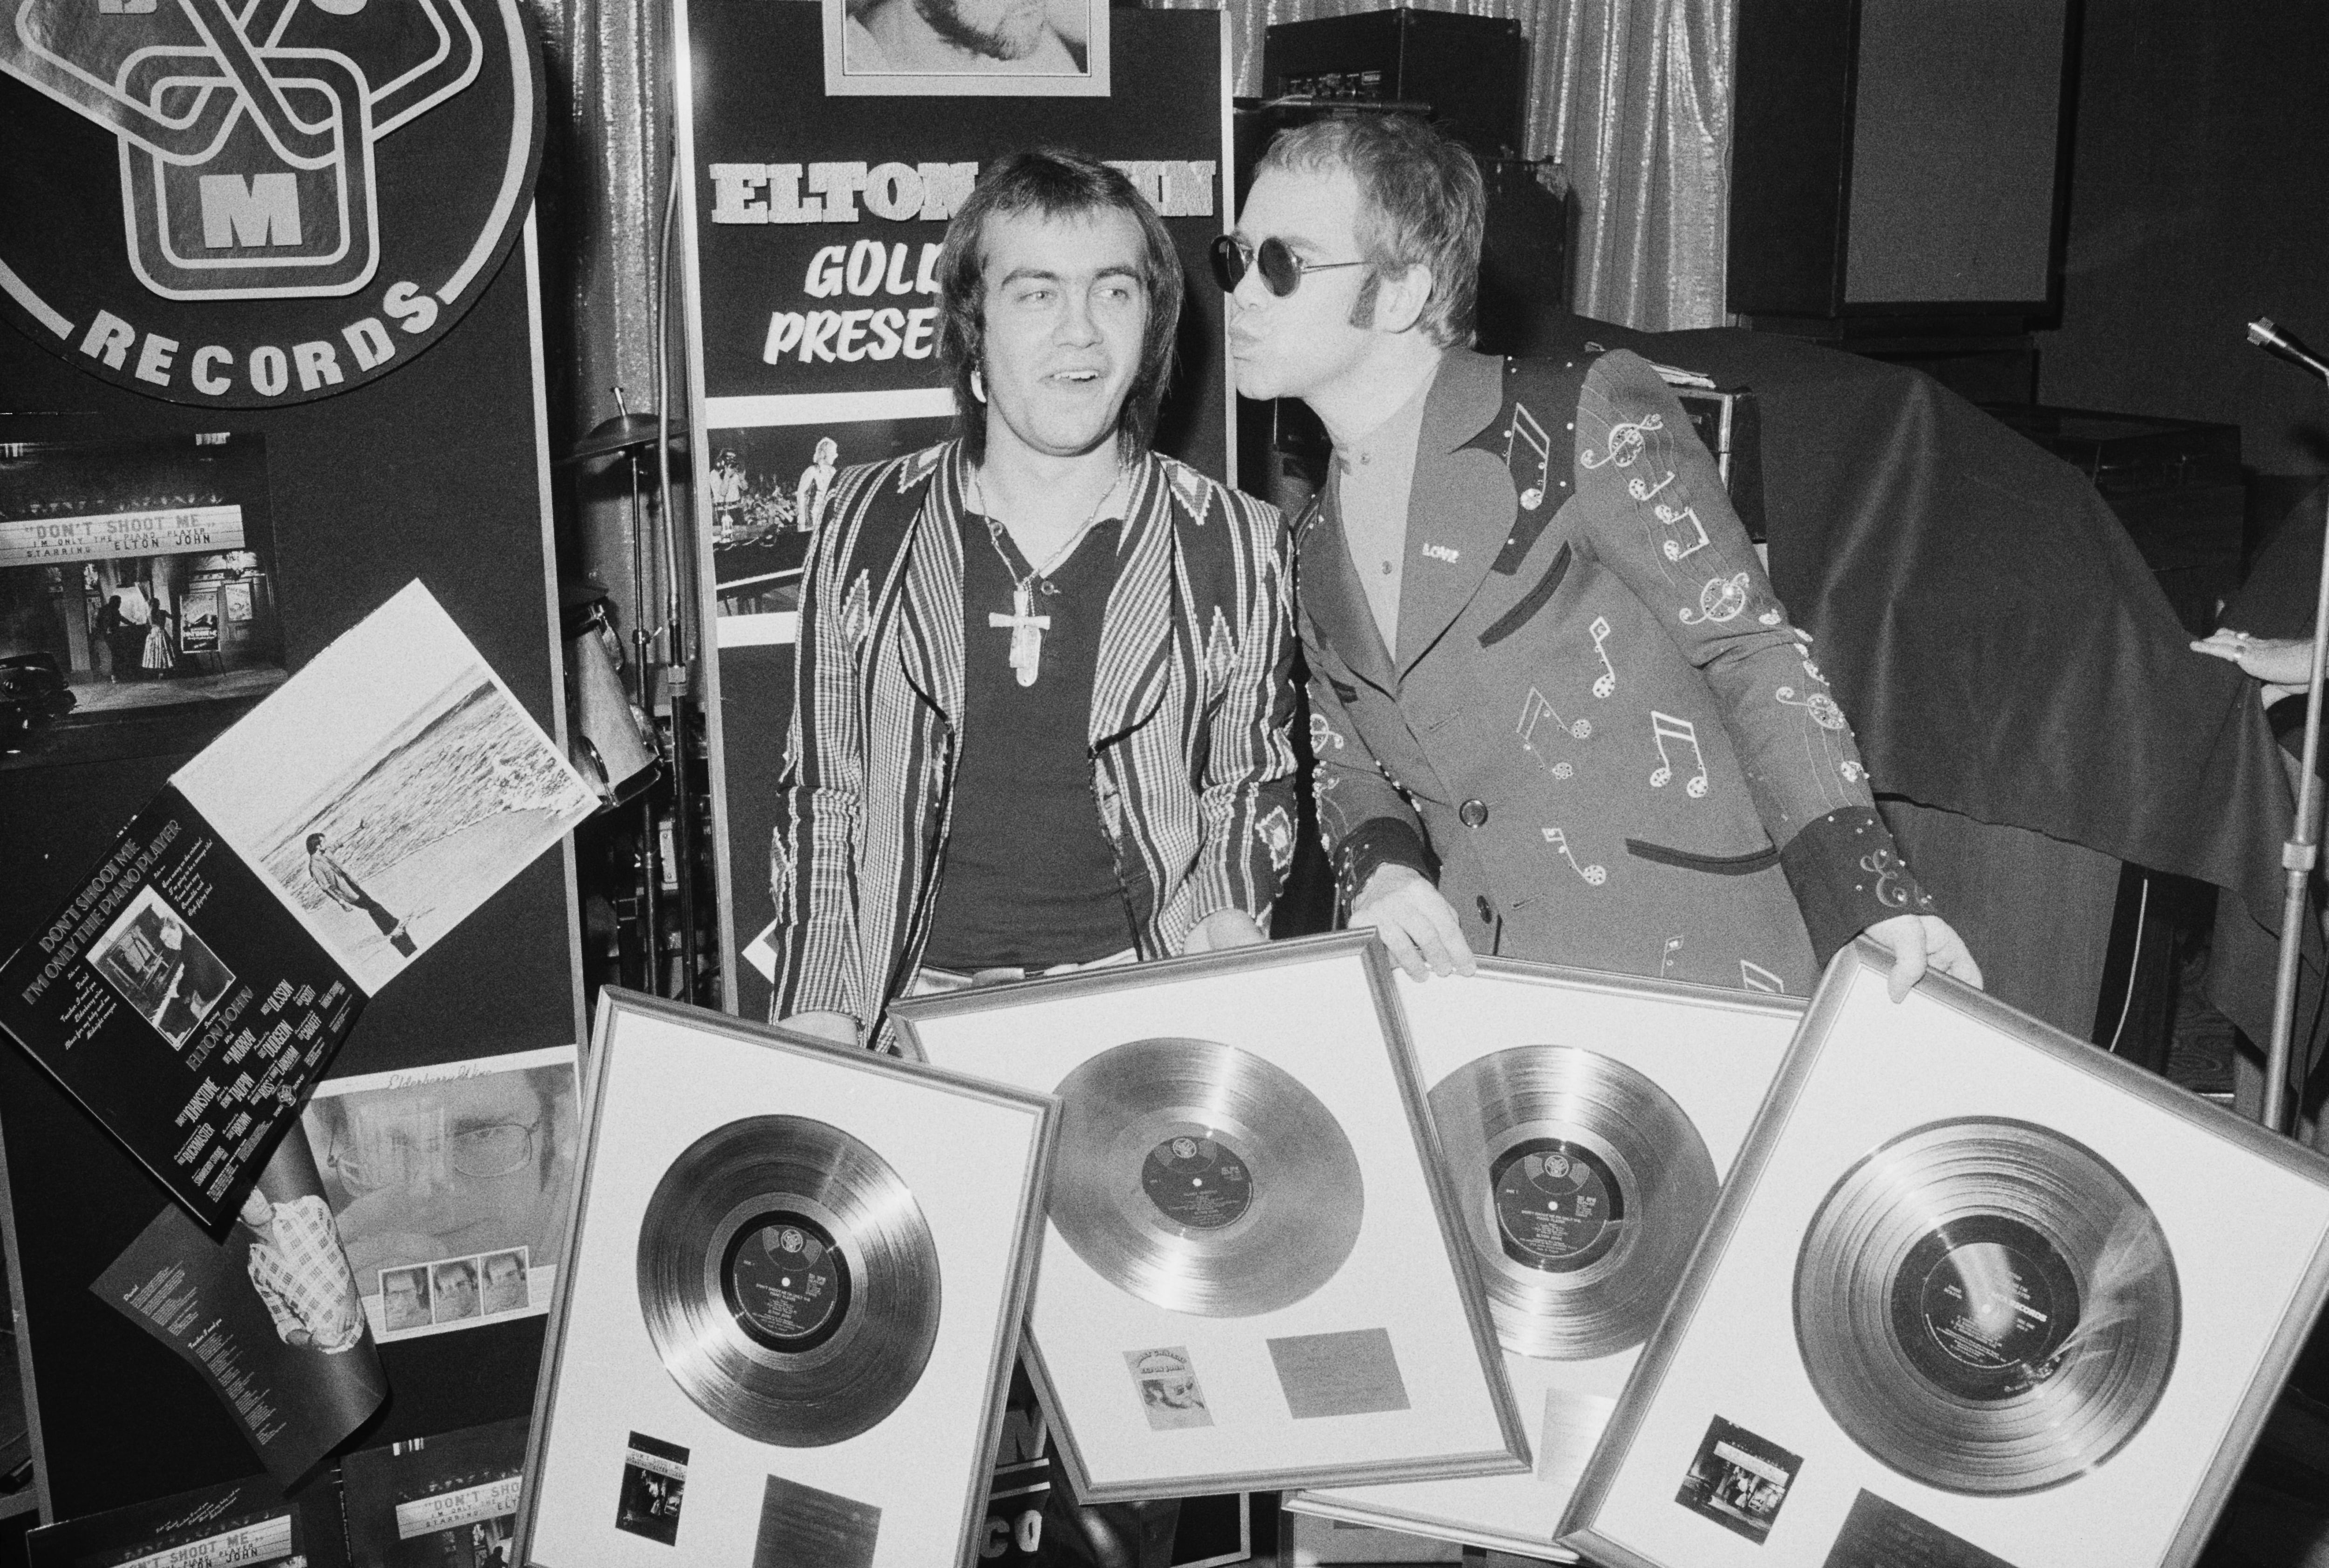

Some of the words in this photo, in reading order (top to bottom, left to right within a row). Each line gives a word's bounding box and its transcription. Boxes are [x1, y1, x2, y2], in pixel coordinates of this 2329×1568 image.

[199, 173, 302, 249] M
[80, 281, 439, 397] RECORDS
[763, 307, 940, 365] PRESE
[107, 516, 164, 533] SHOOT
[114, 538, 160, 552] ELTON
[175, 534, 211, 546] JOHN
[22, 974, 49, 1004] I'M
[45, 937, 78, 978] ONLY
[73, 909, 104, 943] THE
[99, 868, 140, 914] PIANO
[136, 820, 181, 872] PLAYER
[39, 905, 80, 952] DON'T
[76, 860, 119, 910] SHOOT
[114, 839, 140, 866] ME
[267, 979, 293, 1011] OLSSON
[298, 985, 315, 1005] SCOTT
[186, 1024, 223, 1071] ELTON
[218, 986, 253, 1029] JOHN
[227, 1028, 256, 1063] MURRAY
[262, 1020, 296, 1057] DUDGEON
[183, 1077, 219, 1122] JOHNSTONE
[228, 1072, 254, 1102] TAUPIN
[231, 1111, 252, 1136] BROWN
[179, 1123, 214, 1163] BUCKMASTER
